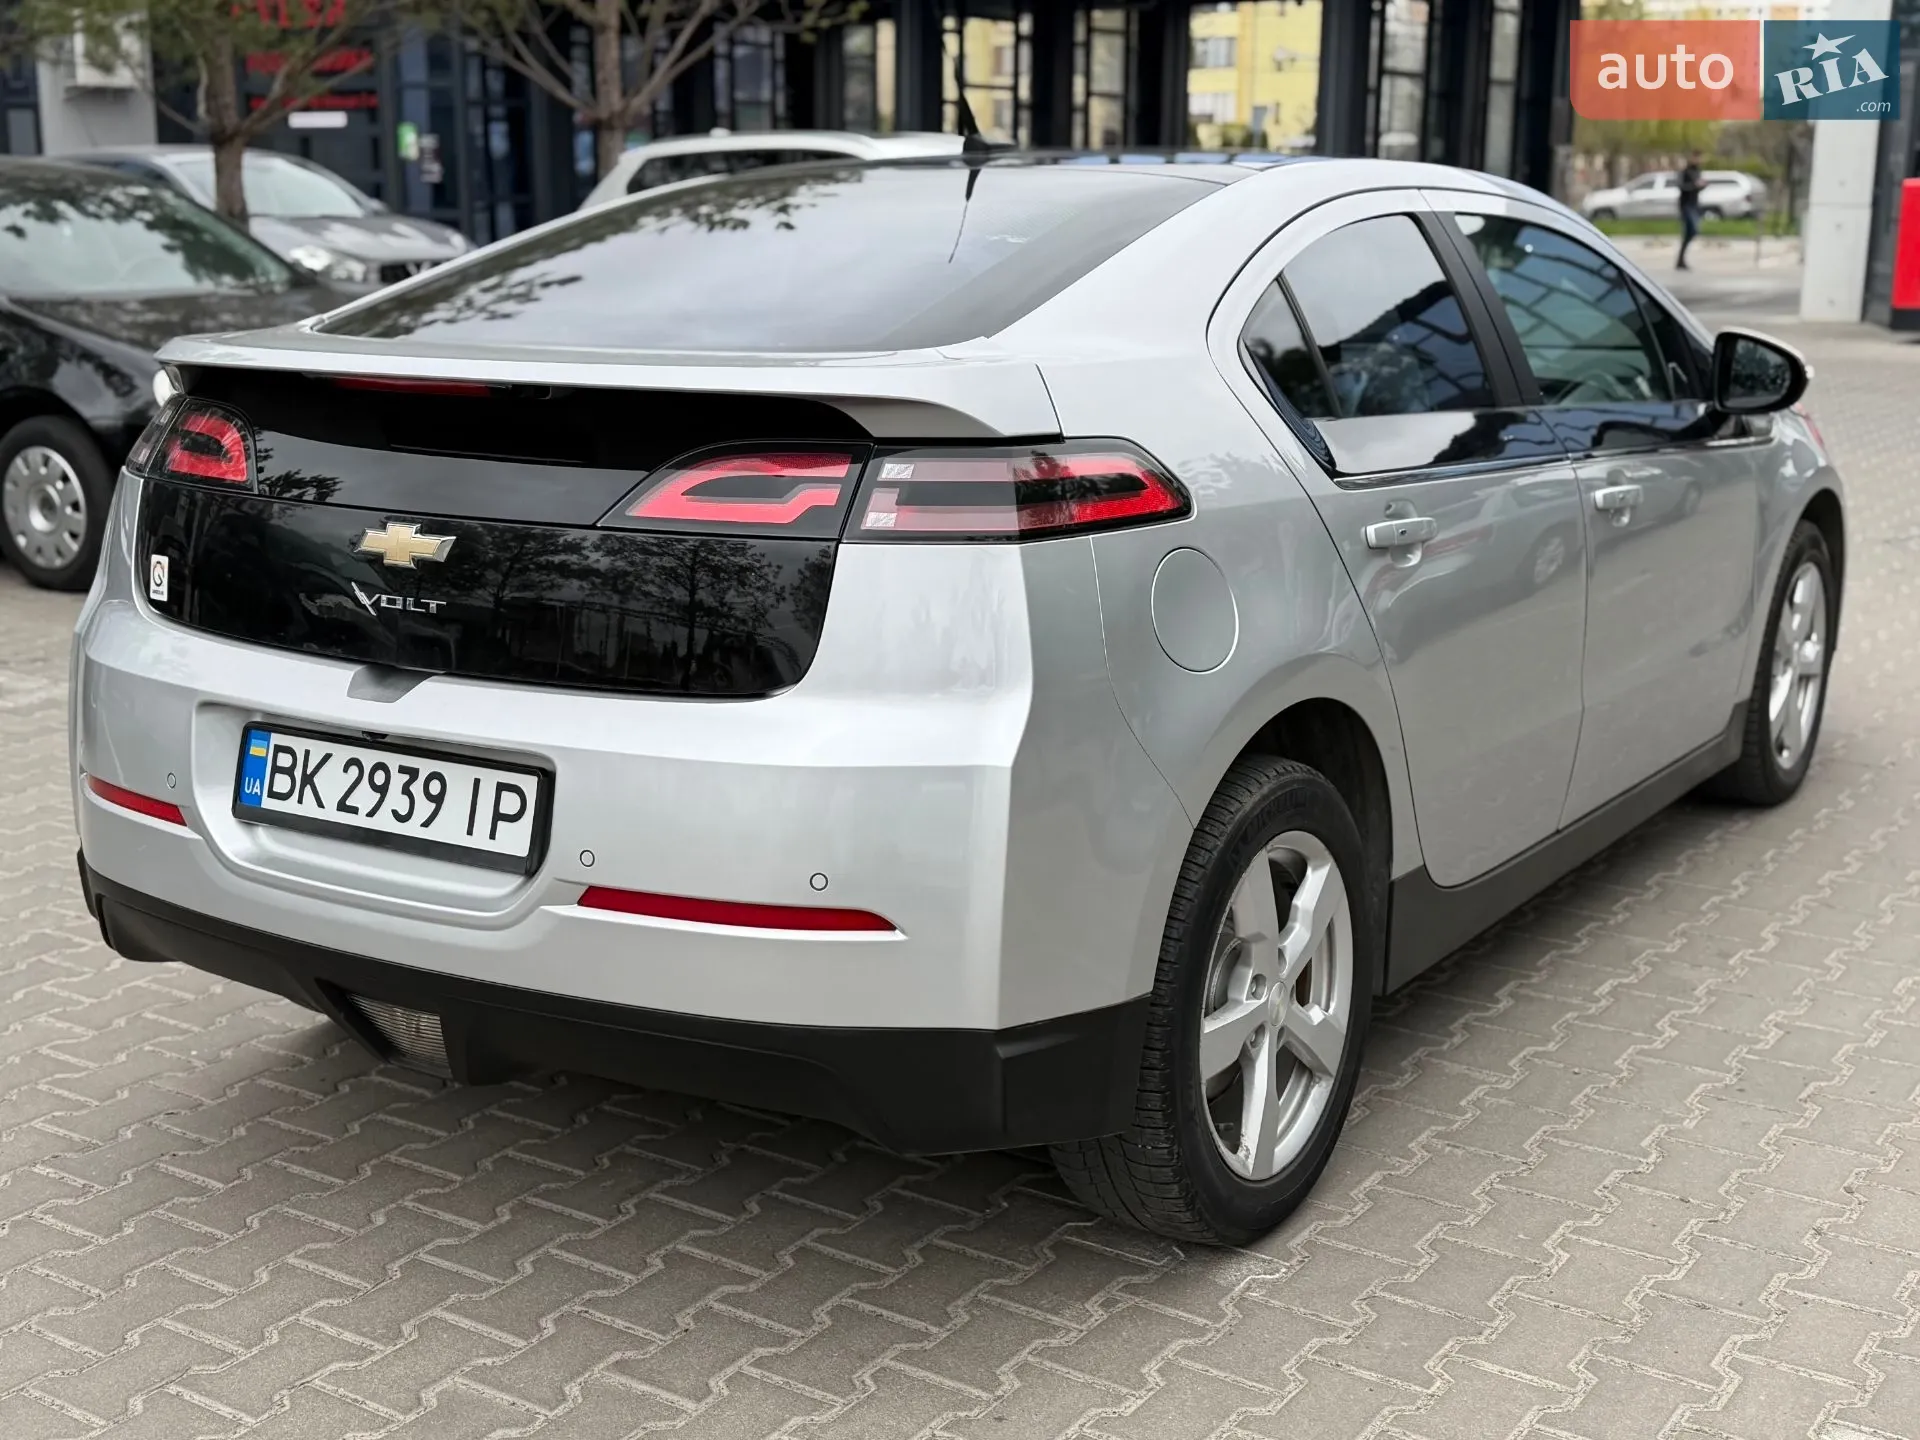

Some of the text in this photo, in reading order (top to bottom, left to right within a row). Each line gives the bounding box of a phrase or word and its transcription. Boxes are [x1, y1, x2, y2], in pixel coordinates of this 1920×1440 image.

[351, 582, 447, 616] VOLT
[244, 777, 260, 796] UA
[267, 744, 528, 840] BK 2939 IP
